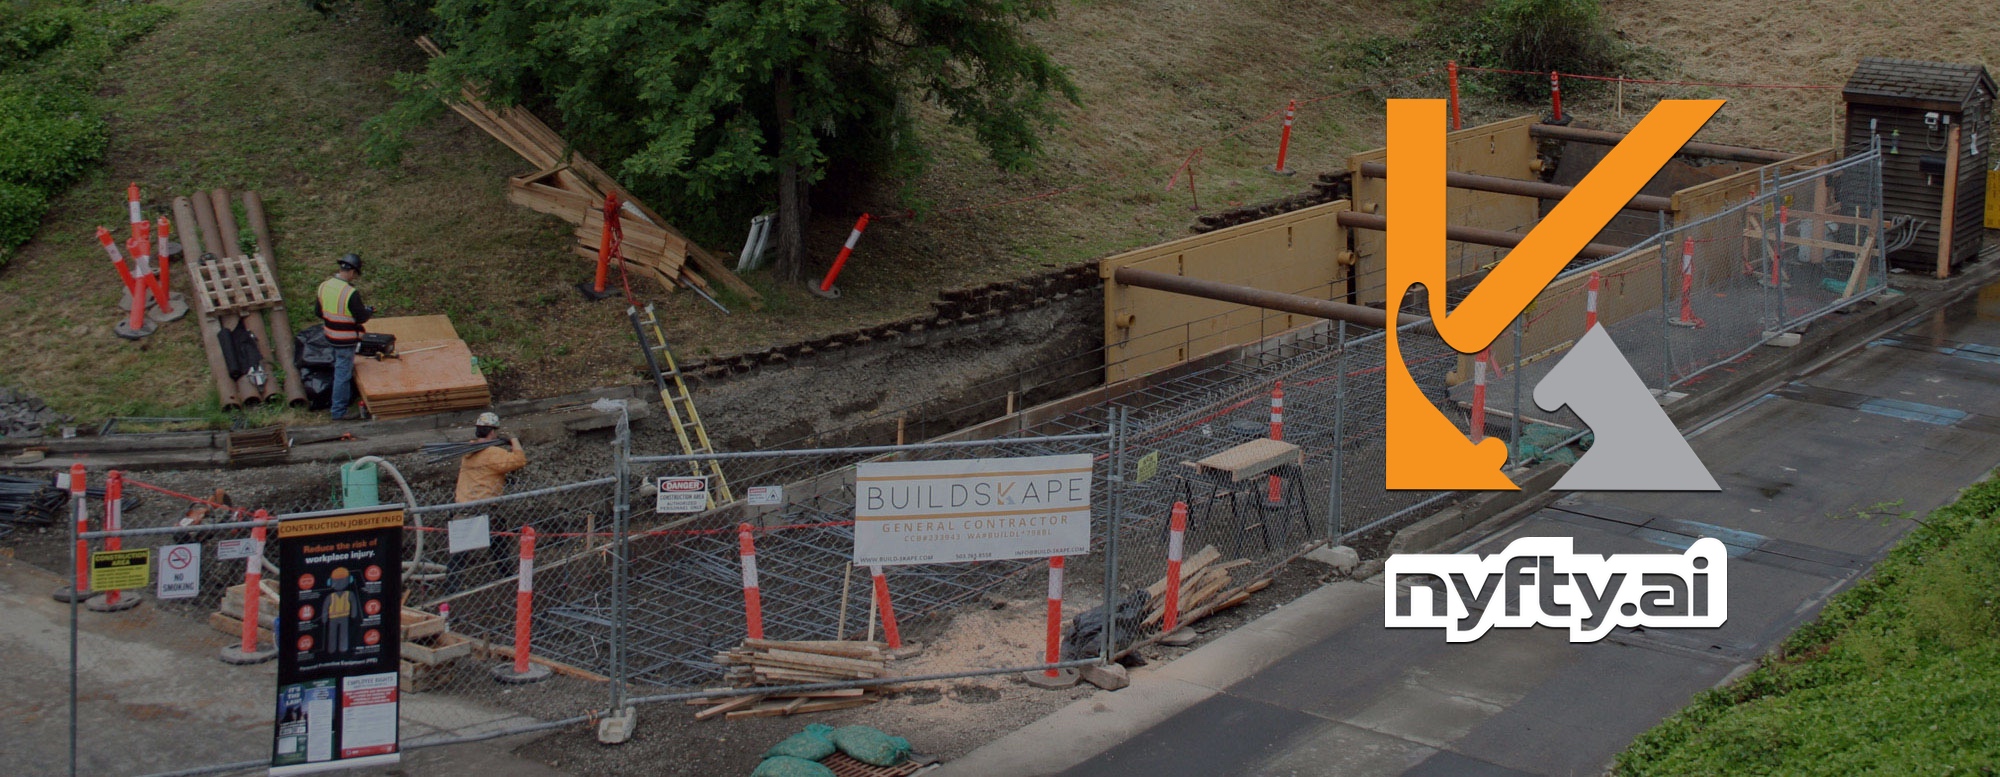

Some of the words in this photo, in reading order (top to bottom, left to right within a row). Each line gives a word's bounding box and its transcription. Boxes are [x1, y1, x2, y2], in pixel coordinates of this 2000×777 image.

[666, 480, 700, 490] DANGER
[867, 478, 1083, 511] BUILDSKAPE
[280, 520, 346, 533] CONSTRUCTION
[348, 517, 380, 528] JOBSITE
[381, 514, 402, 523] INFO
[882, 521, 956, 533] GENERAL
[964, 515, 1069, 530] CONTRACTOR
[303, 545, 334, 554] Reduce
[336, 542, 350, 550] the
[352, 540, 367, 549] risk
[369, 538, 378, 547] of
[96, 552, 148, 561] CONSTRUCTION
[305, 553, 349, 564] workplace
[351, 549, 375, 560] injury.
[173, 573, 184, 581] NO
[163, 582, 194, 592] SMOKING
